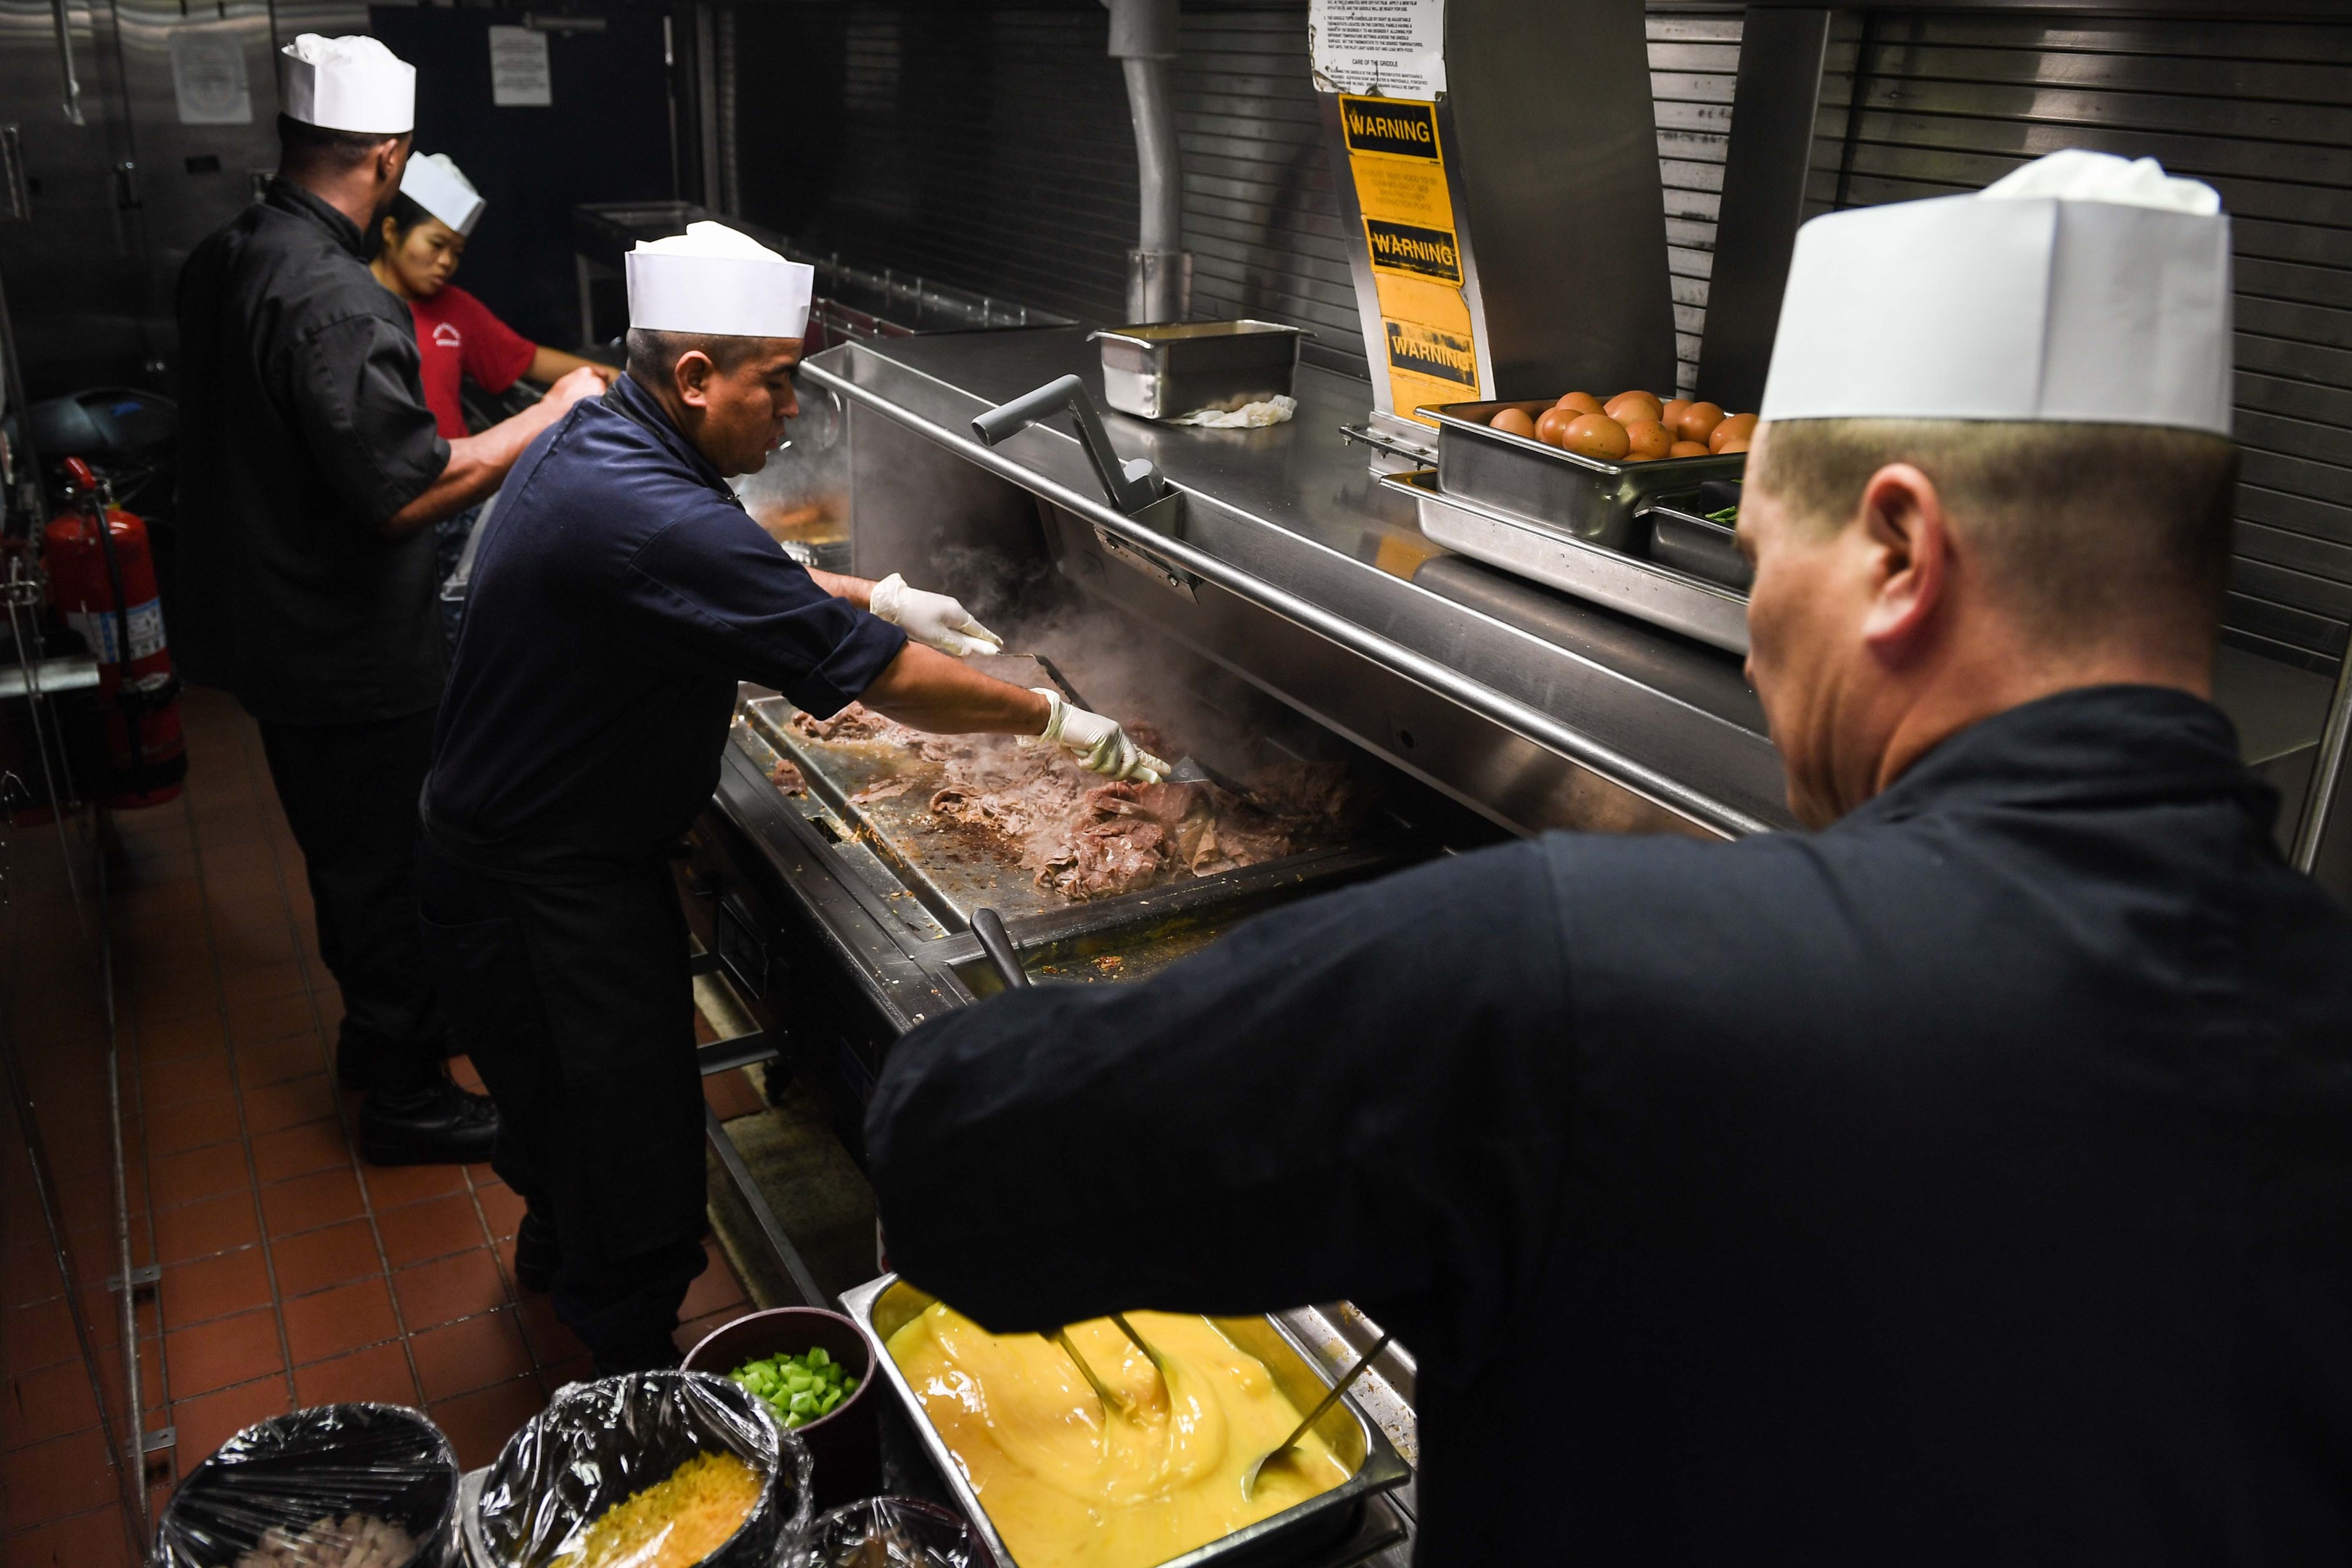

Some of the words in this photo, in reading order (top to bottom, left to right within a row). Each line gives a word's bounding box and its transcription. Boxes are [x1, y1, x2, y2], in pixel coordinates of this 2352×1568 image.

[1349, 114, 1430, 143] WARNING
[1373, 232, 1454, 266] WARNING
[1392, 335, 1470, 372] WARNING
